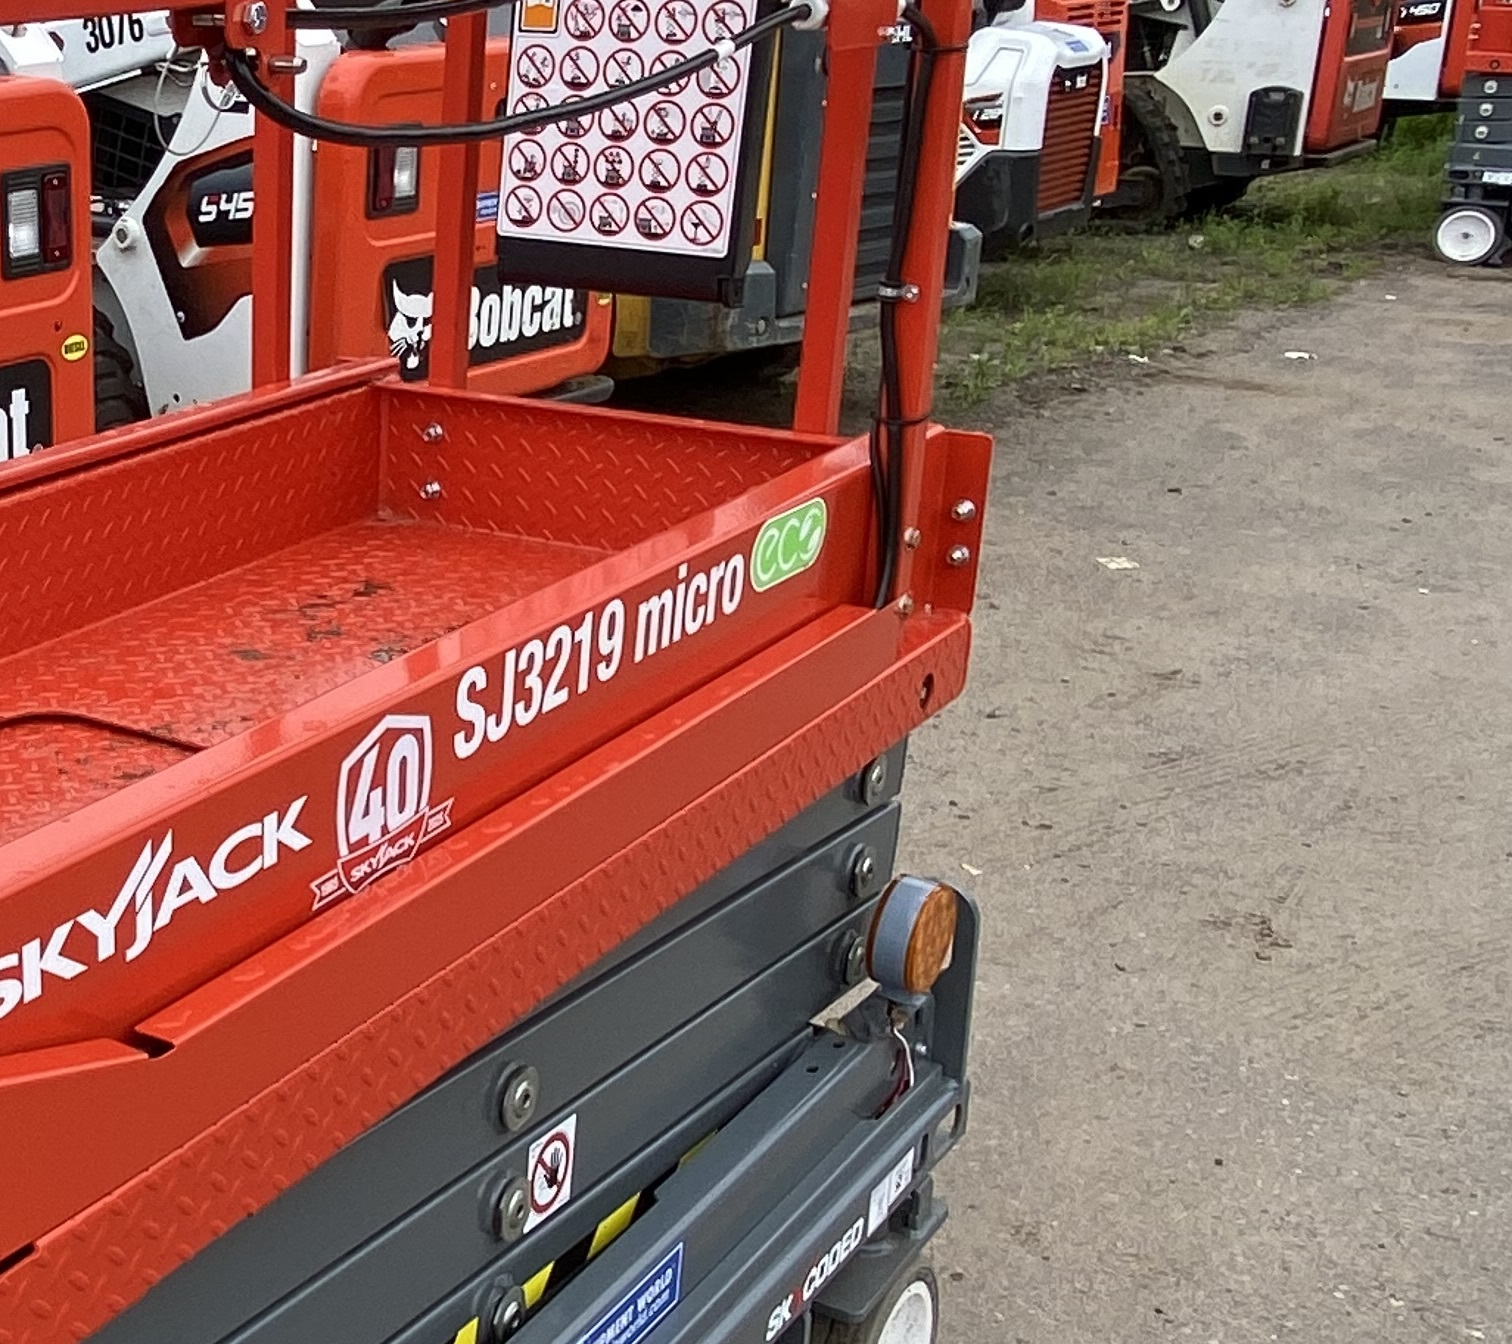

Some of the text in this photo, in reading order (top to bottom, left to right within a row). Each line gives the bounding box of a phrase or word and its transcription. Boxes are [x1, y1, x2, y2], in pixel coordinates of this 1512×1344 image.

[83, 13, 144, 53] 3076
[198, 190, 255, 223] S45
[454, 507, 823, 761] SJ3219 micro eco
[348, 733, 420, 844] 40
[350, 832, 416, 882] SKYJACK
[636, 1267, 673, 1313] WORLD
